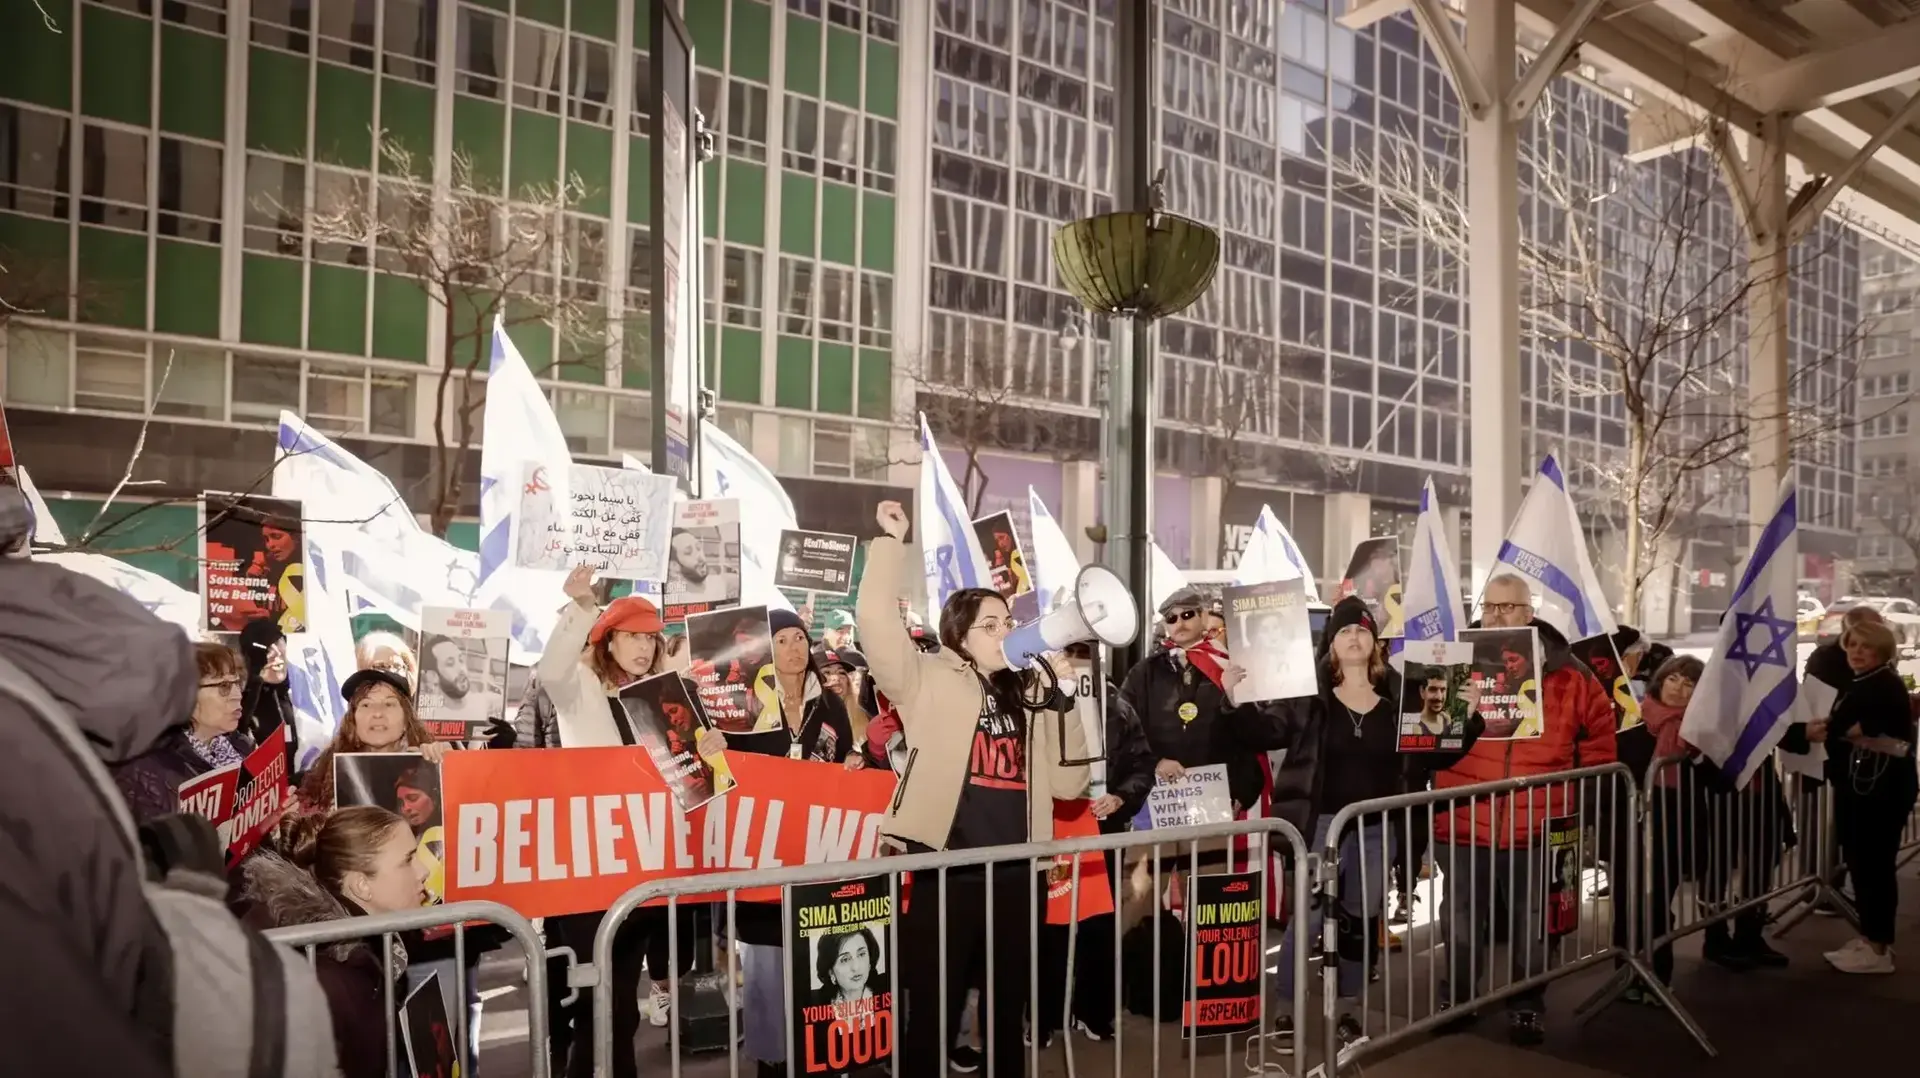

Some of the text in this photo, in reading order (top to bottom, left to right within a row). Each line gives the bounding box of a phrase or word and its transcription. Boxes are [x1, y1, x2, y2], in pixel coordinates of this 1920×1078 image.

[209, 574, 270, 588] Soussana,
[209, 589, 276, 601] We Believe
[210, 603, 233, 613] You
[1232, 596, 1258, 612] SIMA
[716, 698, 734, 706] Are
[727, 709, 745, 718] You
[1185, 771, 1222, 784] YORK
[1151, 786, 1203, 801] STANDS
[1153, 802, 1187, 815] WITH
[457, 792, 695, 888] BELIEVE
[703, 796, 784, 869] ALL
[800, 895, 891, 928] SIMA BAHOUS
[1197, 899, 1260, 925] UN WOMEN
[1197, 928, 1220, 943] YOUR
[1197, 939, 1259, 987] LOUD
[803, 992, 892, 1023] YOUR SILENCE IS
[805, 1009, 892, 1073] LOUD
